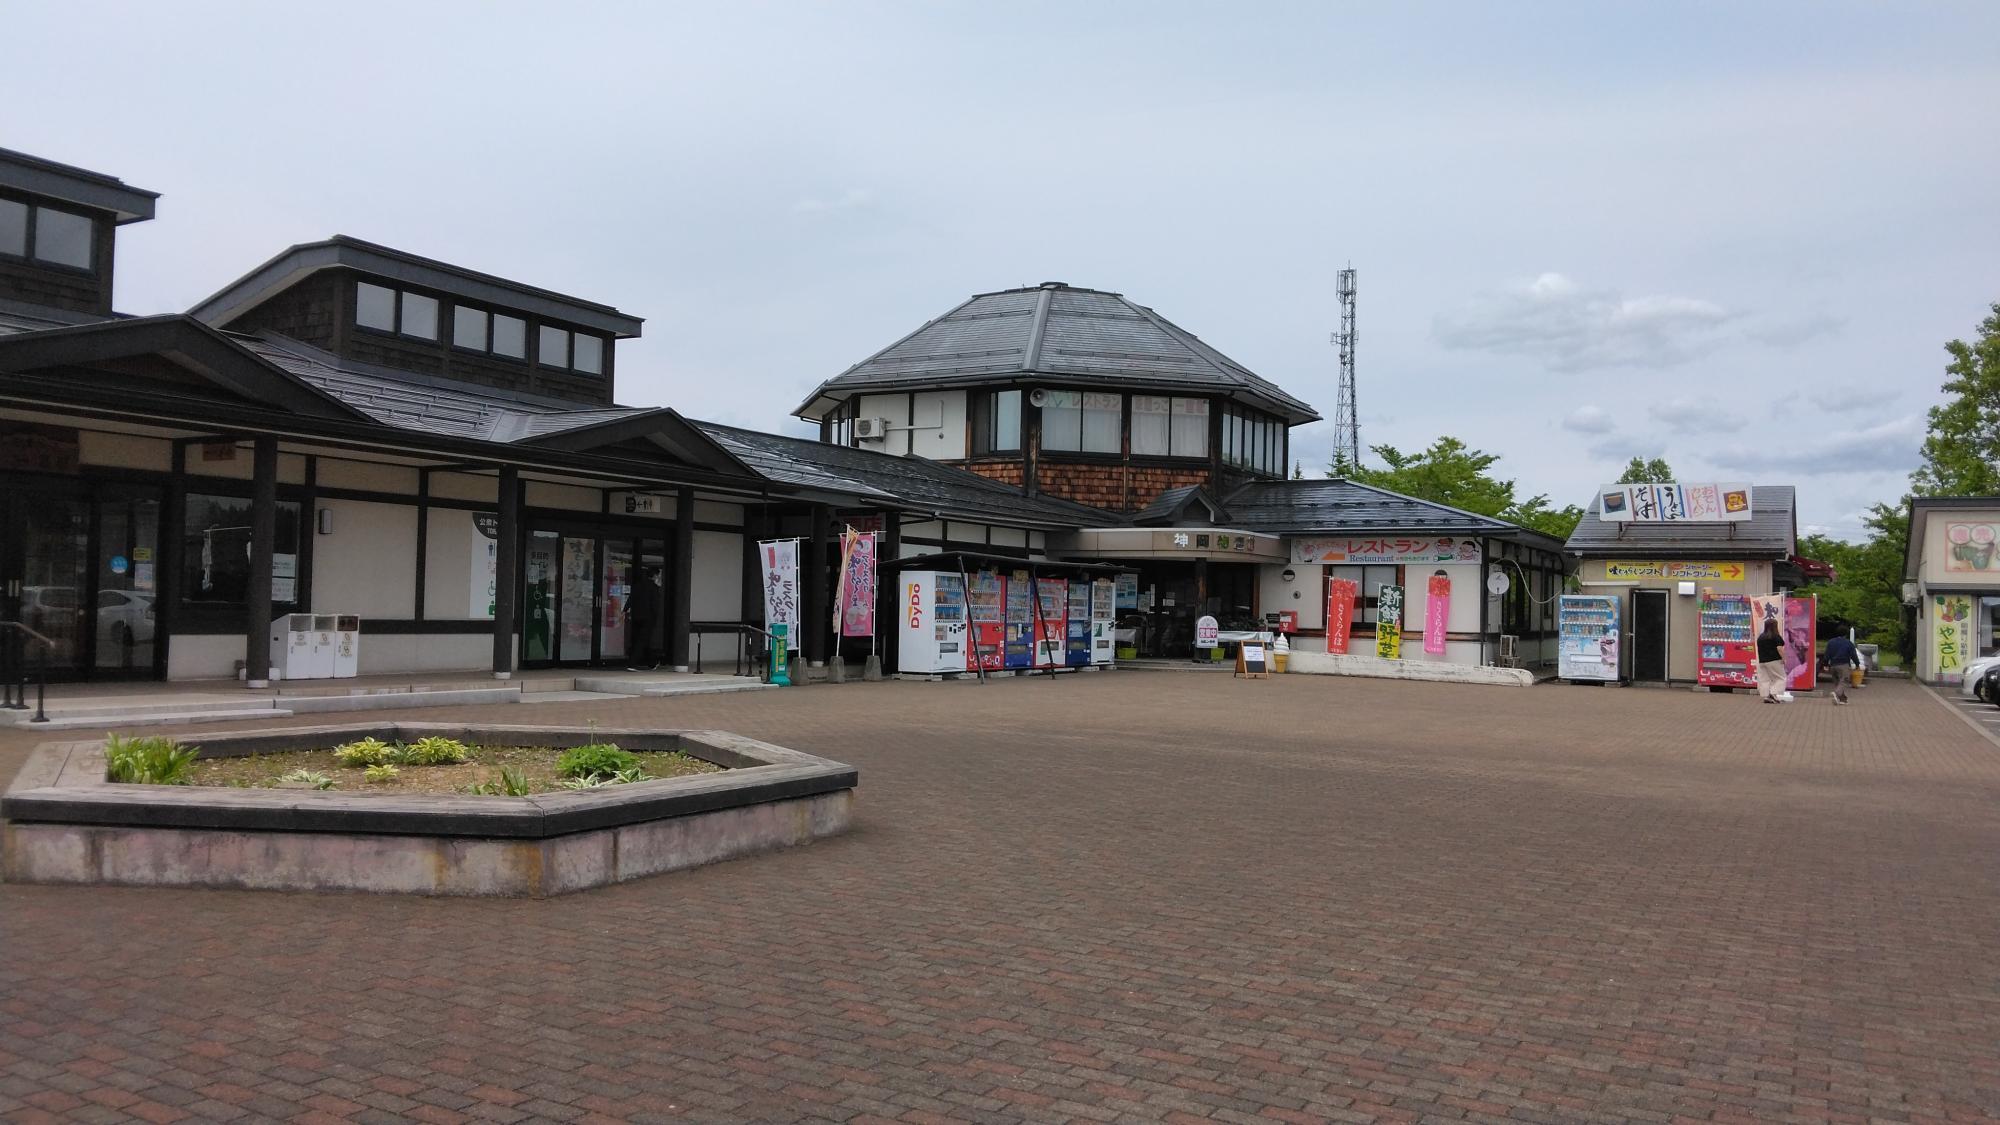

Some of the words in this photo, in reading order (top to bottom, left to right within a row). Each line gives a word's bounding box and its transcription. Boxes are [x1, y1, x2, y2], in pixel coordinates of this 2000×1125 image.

[479, 518, 498, 527] 公衆ト
[1347, 540, 1429, 554] レストラン
[1350, 554, 1394, 563] Restaurant
[1672, 570, 1721, 578] ソフトクリーム
[911, 583, 922, 629] DyDo
[1333, 603, 1344, 646] さくらんぼ
[1433, 601, 1442, 645] さくらんぼ
[1200, 628, 1217, 639] 営業中
[1939, 626, 1957, 669] やさい
